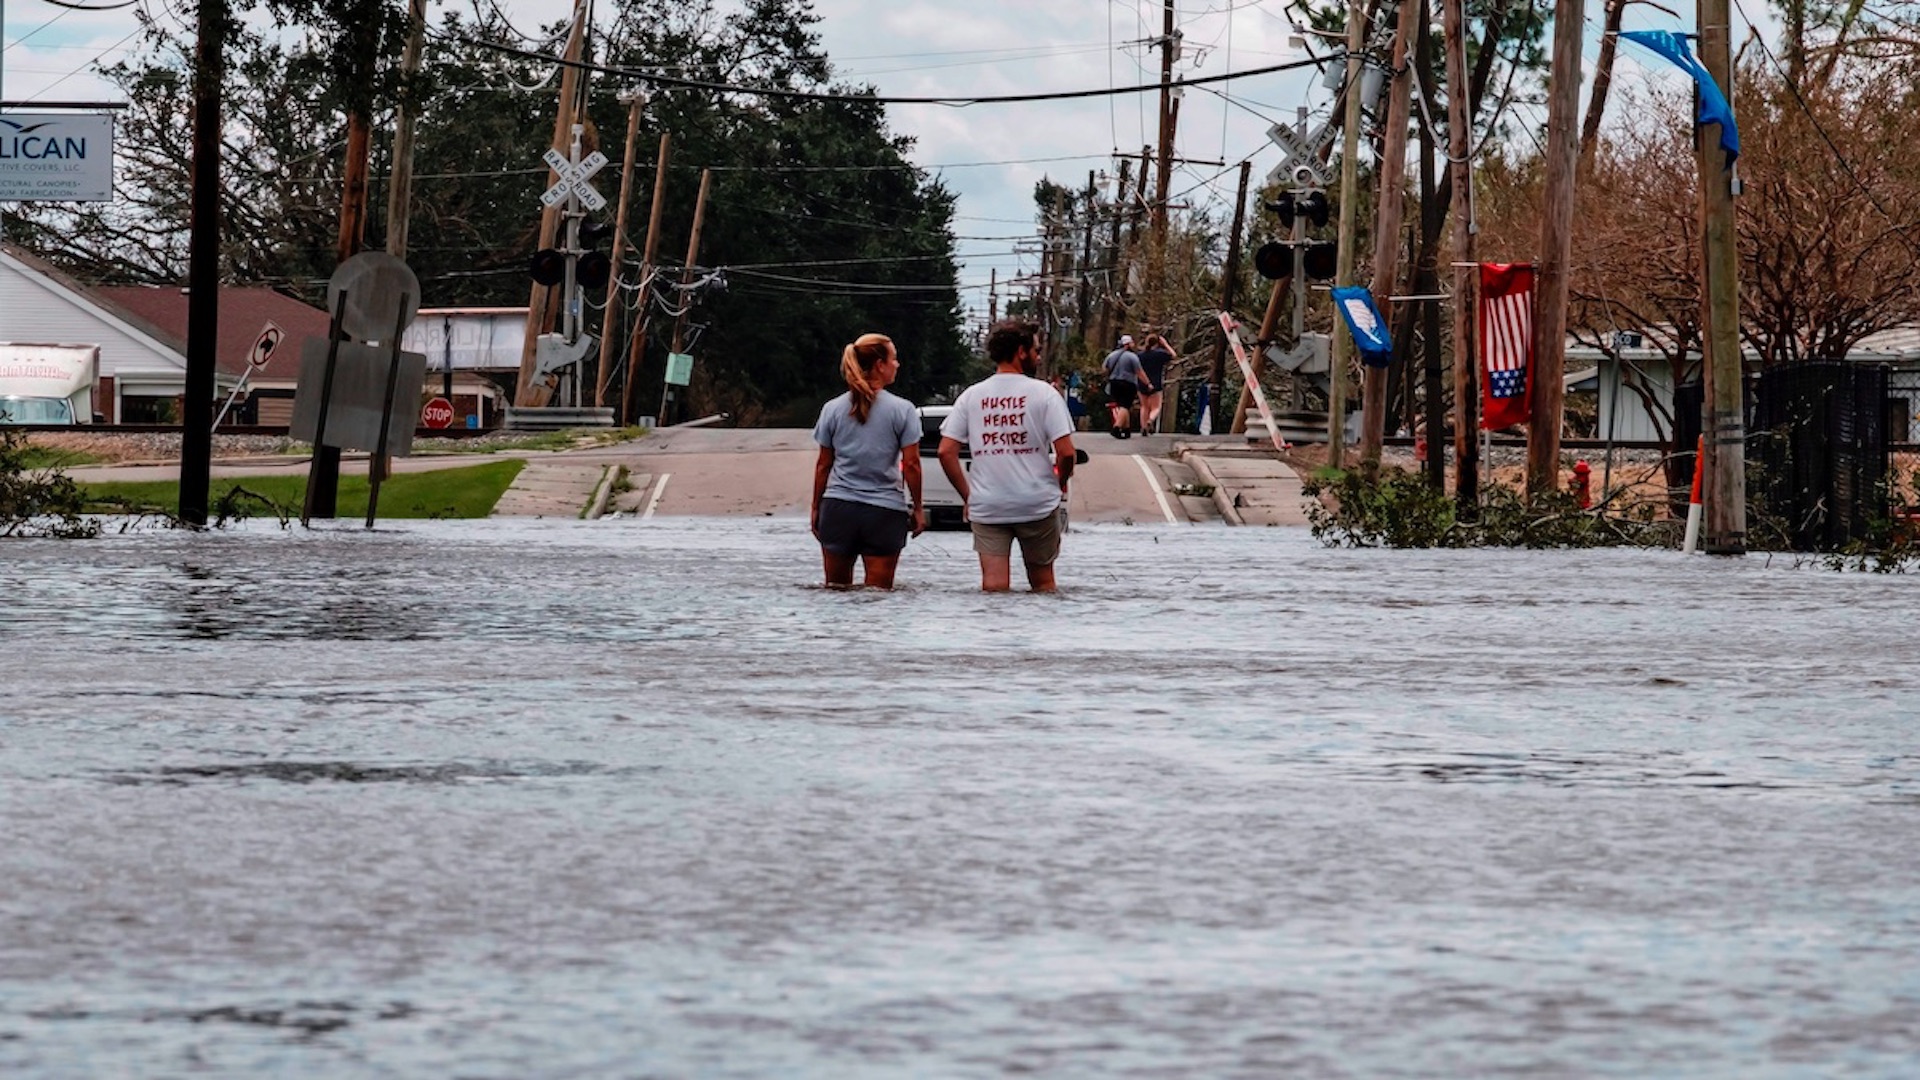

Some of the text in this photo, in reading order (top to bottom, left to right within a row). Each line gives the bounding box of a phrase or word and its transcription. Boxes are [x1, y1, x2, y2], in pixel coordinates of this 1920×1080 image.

[0, 136, 85, 159] LICAN
[1277, 124, 1333, 181] RAILROAD
[0, 163, 19, 171] TIVE
[544, 154, 600, 204] CROSSING
[546, 151, 597, 206] RAILROAD
[981, 396, 1026, 410] HUSTLE
[424, 407, 451, 421] STOP
[983, 412, 1026, 427] HEART
[982, 431, 1028, 446] DESIRE
